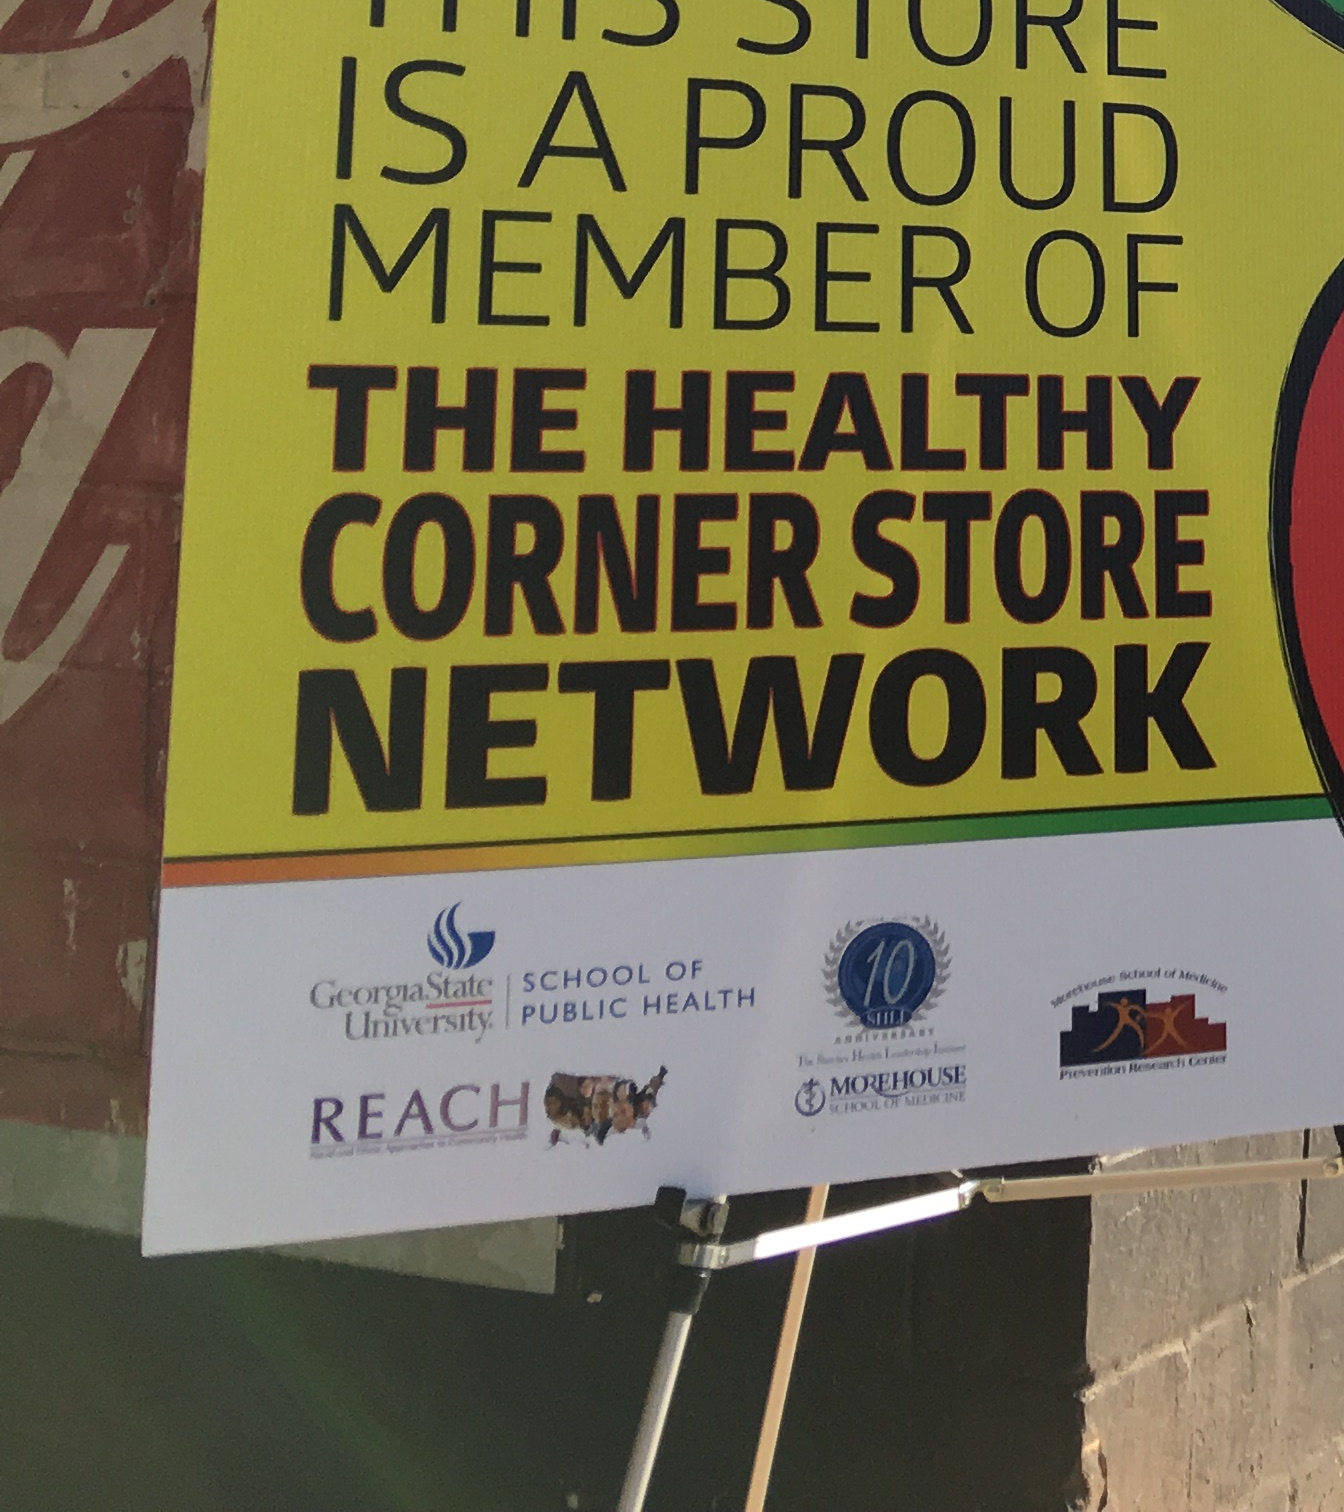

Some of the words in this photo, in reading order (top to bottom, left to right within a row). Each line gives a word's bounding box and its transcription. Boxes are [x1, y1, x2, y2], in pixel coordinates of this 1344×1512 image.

[334, 55, 469, 187] IS
[516, 69, 628, 194] A
[683, 76, 1180, 215] PROUD
[327, 202, 976, 336] MEMBER
[1024, 228, 1185, 339] OF
[307, 363, 588, 474] THE
[622, 367, 1202, 474] HEALTHY
[300, 490, 824, 644] CORNER
[848, 487, 1214, 630] STORE
[291, 640, 1218, 817] NETWORK
[522, 962, 651, 993] SCHOOL
[665, 960, 703, 982] OF
[866, 938, 915, 1008] 10
[1119, 967, 1162, 981] School
[1164, 968, 1177, 979] of
[1178, 969, 1229, 995] Medicine
[521, 997, 628, 1026] PUBLIC
[642, 987, 756, 1016] HEALTH
[830, 1063, 968, 1099] MOREHOUSE
[1059, 1061, 1127, 1080] Prevention
[1129, 1056, 1187, 1075] Research
[1188, 1053, 1228, 1067] Center
[310, 1080, 531, 1145] REACH
[828, 1098, 882, 1115] SCHOOL
[884, 1097, 900, 1110] OF
[903, 1090, 967, 1108] MEDICINE
